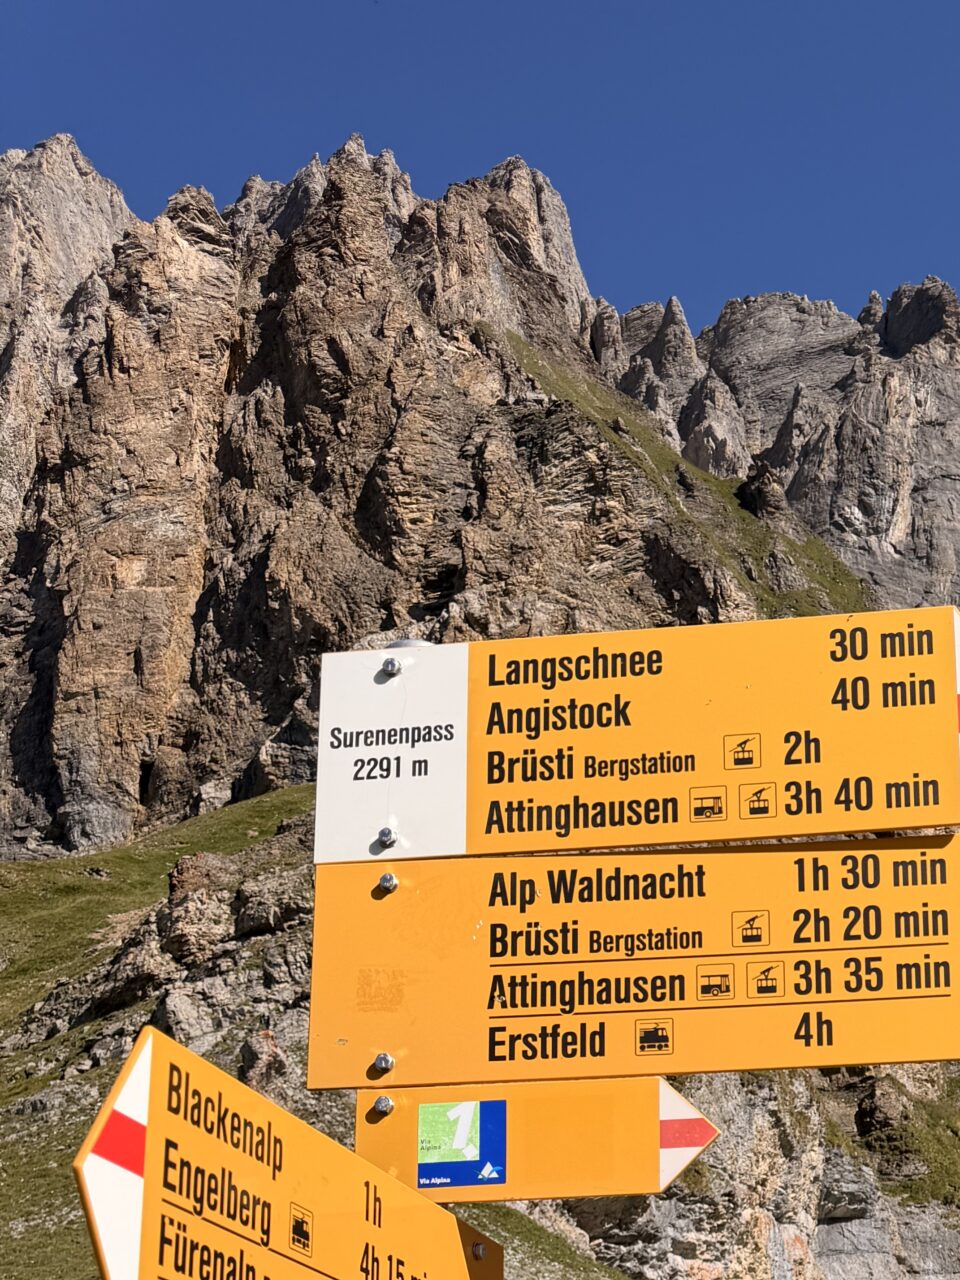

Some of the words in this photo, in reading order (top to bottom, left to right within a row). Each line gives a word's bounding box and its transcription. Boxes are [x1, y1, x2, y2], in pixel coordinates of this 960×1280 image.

[489, 647, 662, 690] Langschnee
[830, 627, 867, 661] 30
[881, 624, 933, 657] min
[487, 694, 630, 740] Angistock
[832, 677, 869, 710] 40
[883, 673, 935, 707] min
[330, 725, 453, 749] Surenenpass
[488, 747, 573, 784] Brüsti
[585, 751, 694, 781] Bergstation
[785, 731, 820, 764] 2h
[354, 757, 400, 780] 2291
[412, 760, 427, 776] m
[486, 796, 678, 837] Attinghausen
[785, 781, 821, 815] 3h
[835, 777, 872, 811] 40
[886, 773, 939, 808] min
[489, 872, 535, 913] Alp
[548, 865, 705, 903] Waldnacht
[794, 858, 828, 891] 1h
[842, 854, 880, 889] 30
[893, 852, 946, 886] min
[490, 920, 578, 957] Brüsti
[590, 927, 702, 956] Bergstation
[793, 909, 829, 943] 2h
[843, 905, 881, 940] 20
[895, 903, 948, 937] min
[488, 971, 685, 1013] Attinghausen
[794, 960, 831, 995] 3h
[844, 957, 882, 992] 35
[897, 954, 950, 989] min
[489, 1022, 604, 1061] Erstfeld
[795, 1012, 832, 1046] 4h
[167, 1062, 283, 1181] Blackenalp
[365, 1182, 381, 1227] 1h
[163, 1138, 271, 1248] Engelberg
